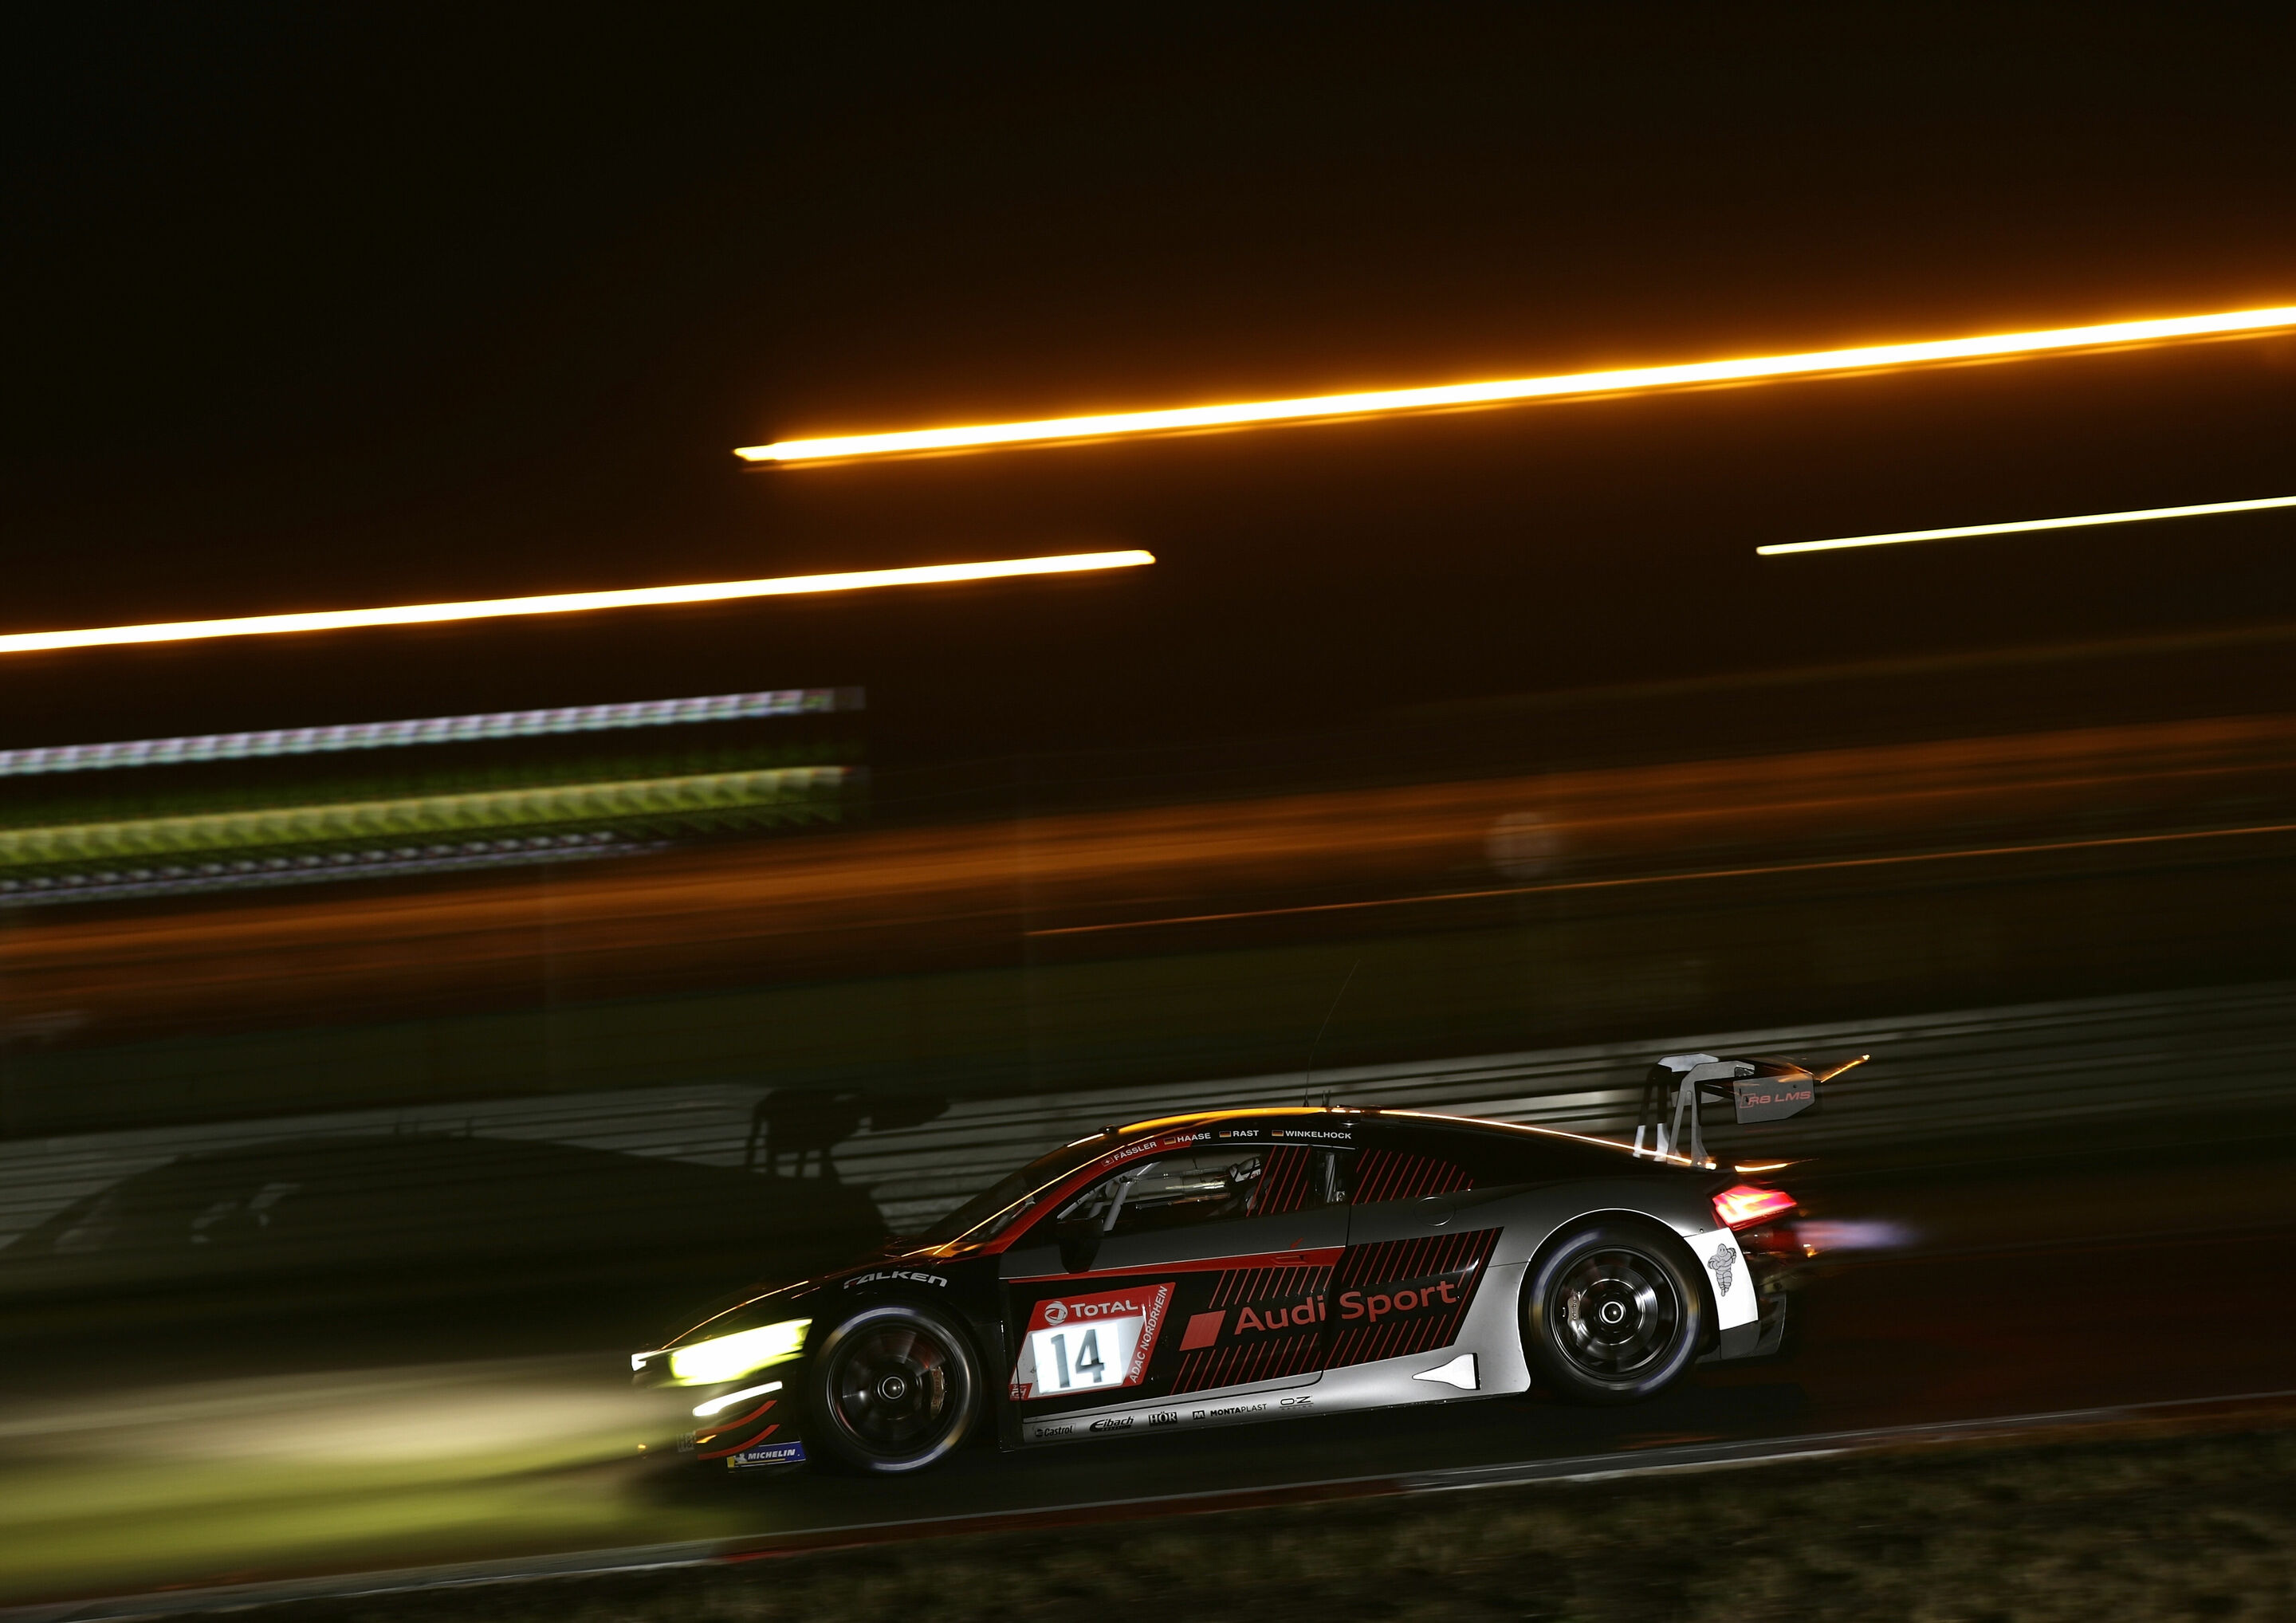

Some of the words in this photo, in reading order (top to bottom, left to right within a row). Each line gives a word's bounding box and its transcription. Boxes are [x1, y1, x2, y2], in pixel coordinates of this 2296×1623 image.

[1774, 1091, 1811, 1102] LMS
[1114, 1141, 1157, 1161] FÄSSLER
[1177, 1133, 1211, 1142] HAASE
[1285, 1130, 1352, 1139] WINKELHOCK
[843, 1271, 948, 1289] FALKEN
[1234, 1295, 1326, 1334] Audi
[1339, 1280, 1457, 1322] Sport
[1129, 1351, 1146, 1384] ADAC
[1140, 1286, 1168, 1348] NORDRHEIN
[1050, 1329, 1105, 1388] 14
[1210, 1404, 1268, 1417] MONTAPLAST
[1044, 1425, 1072, 1436] Castrol
[1090, 1416, 1134, 1432] Eibach
[748, 1449, 795, 1460] MICHELIN
